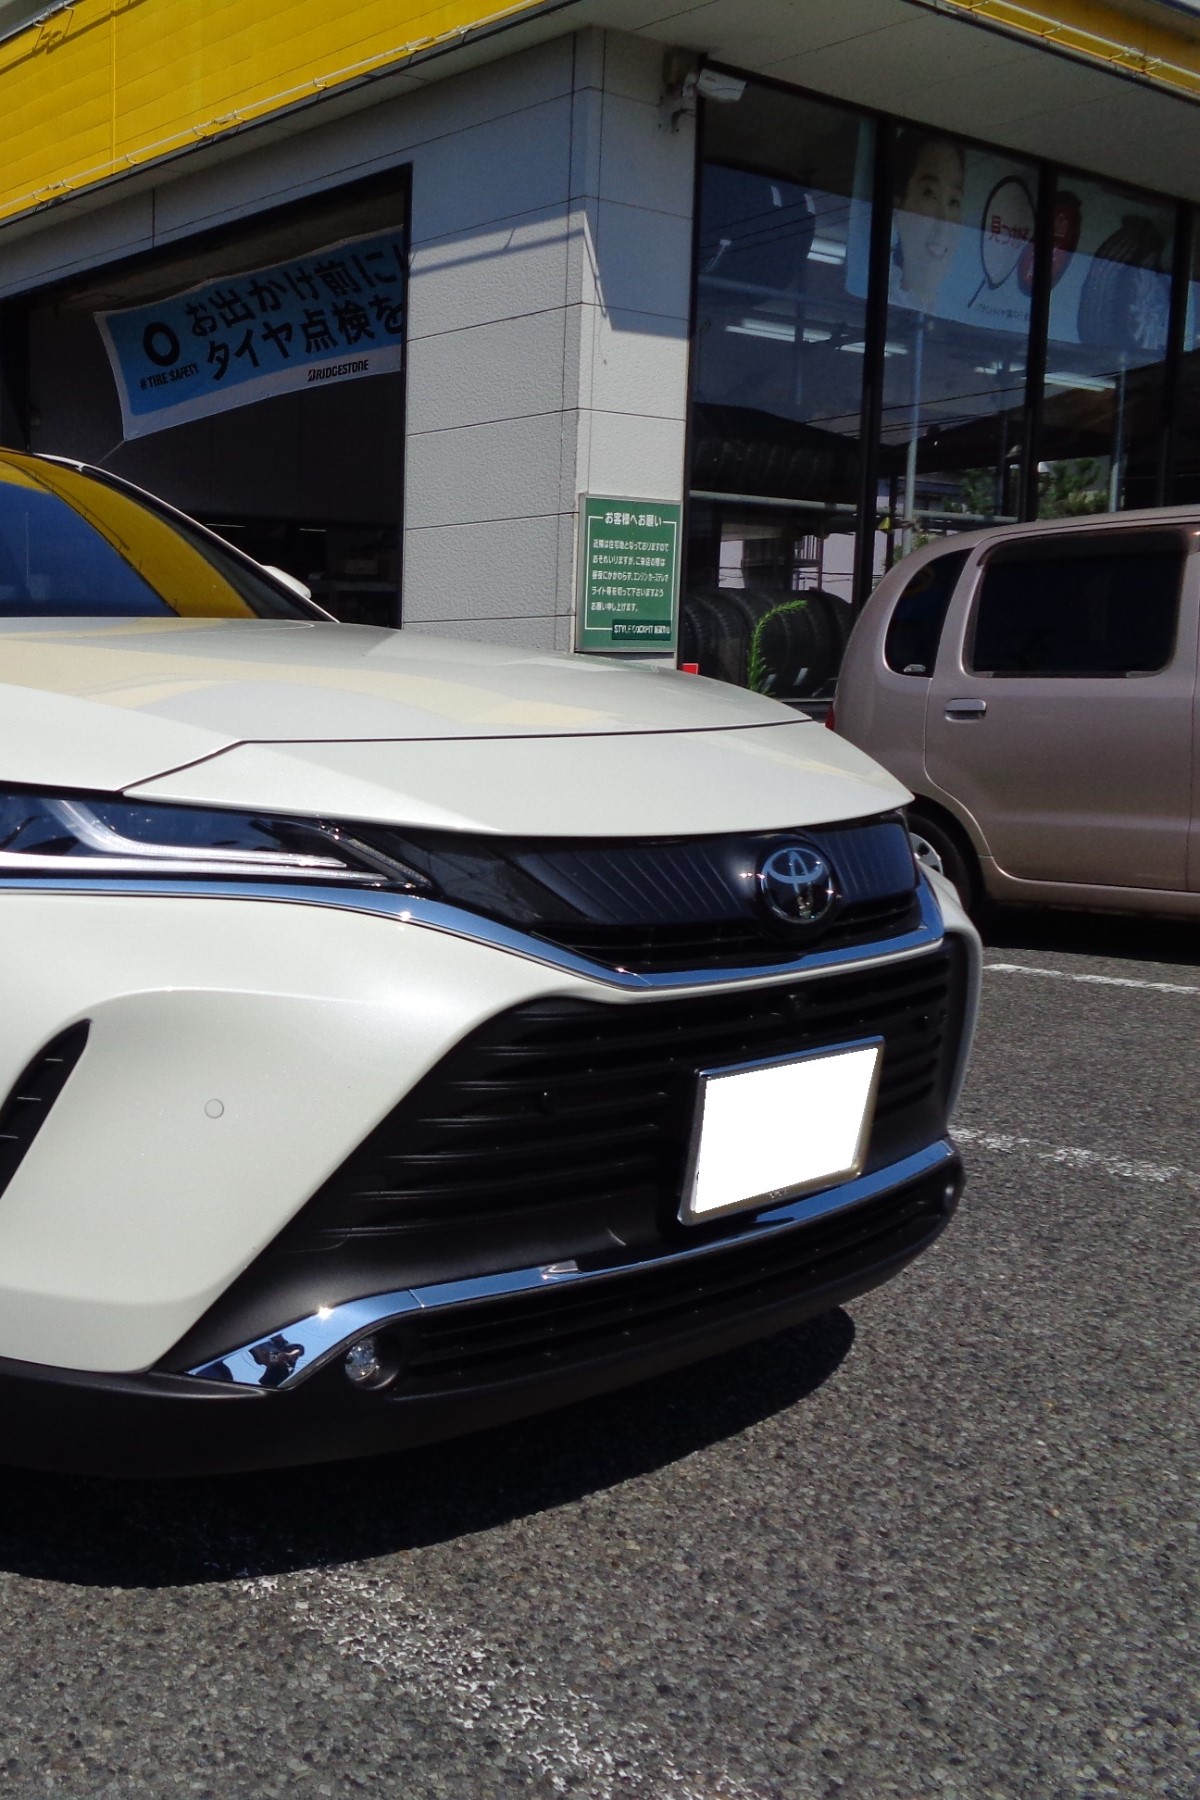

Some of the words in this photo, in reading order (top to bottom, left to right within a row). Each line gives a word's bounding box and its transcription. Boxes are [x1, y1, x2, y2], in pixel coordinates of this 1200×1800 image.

[308, 359, 369, 382] BRIDGESTONE
[605, 512, 662, 527] お客様へお願い
